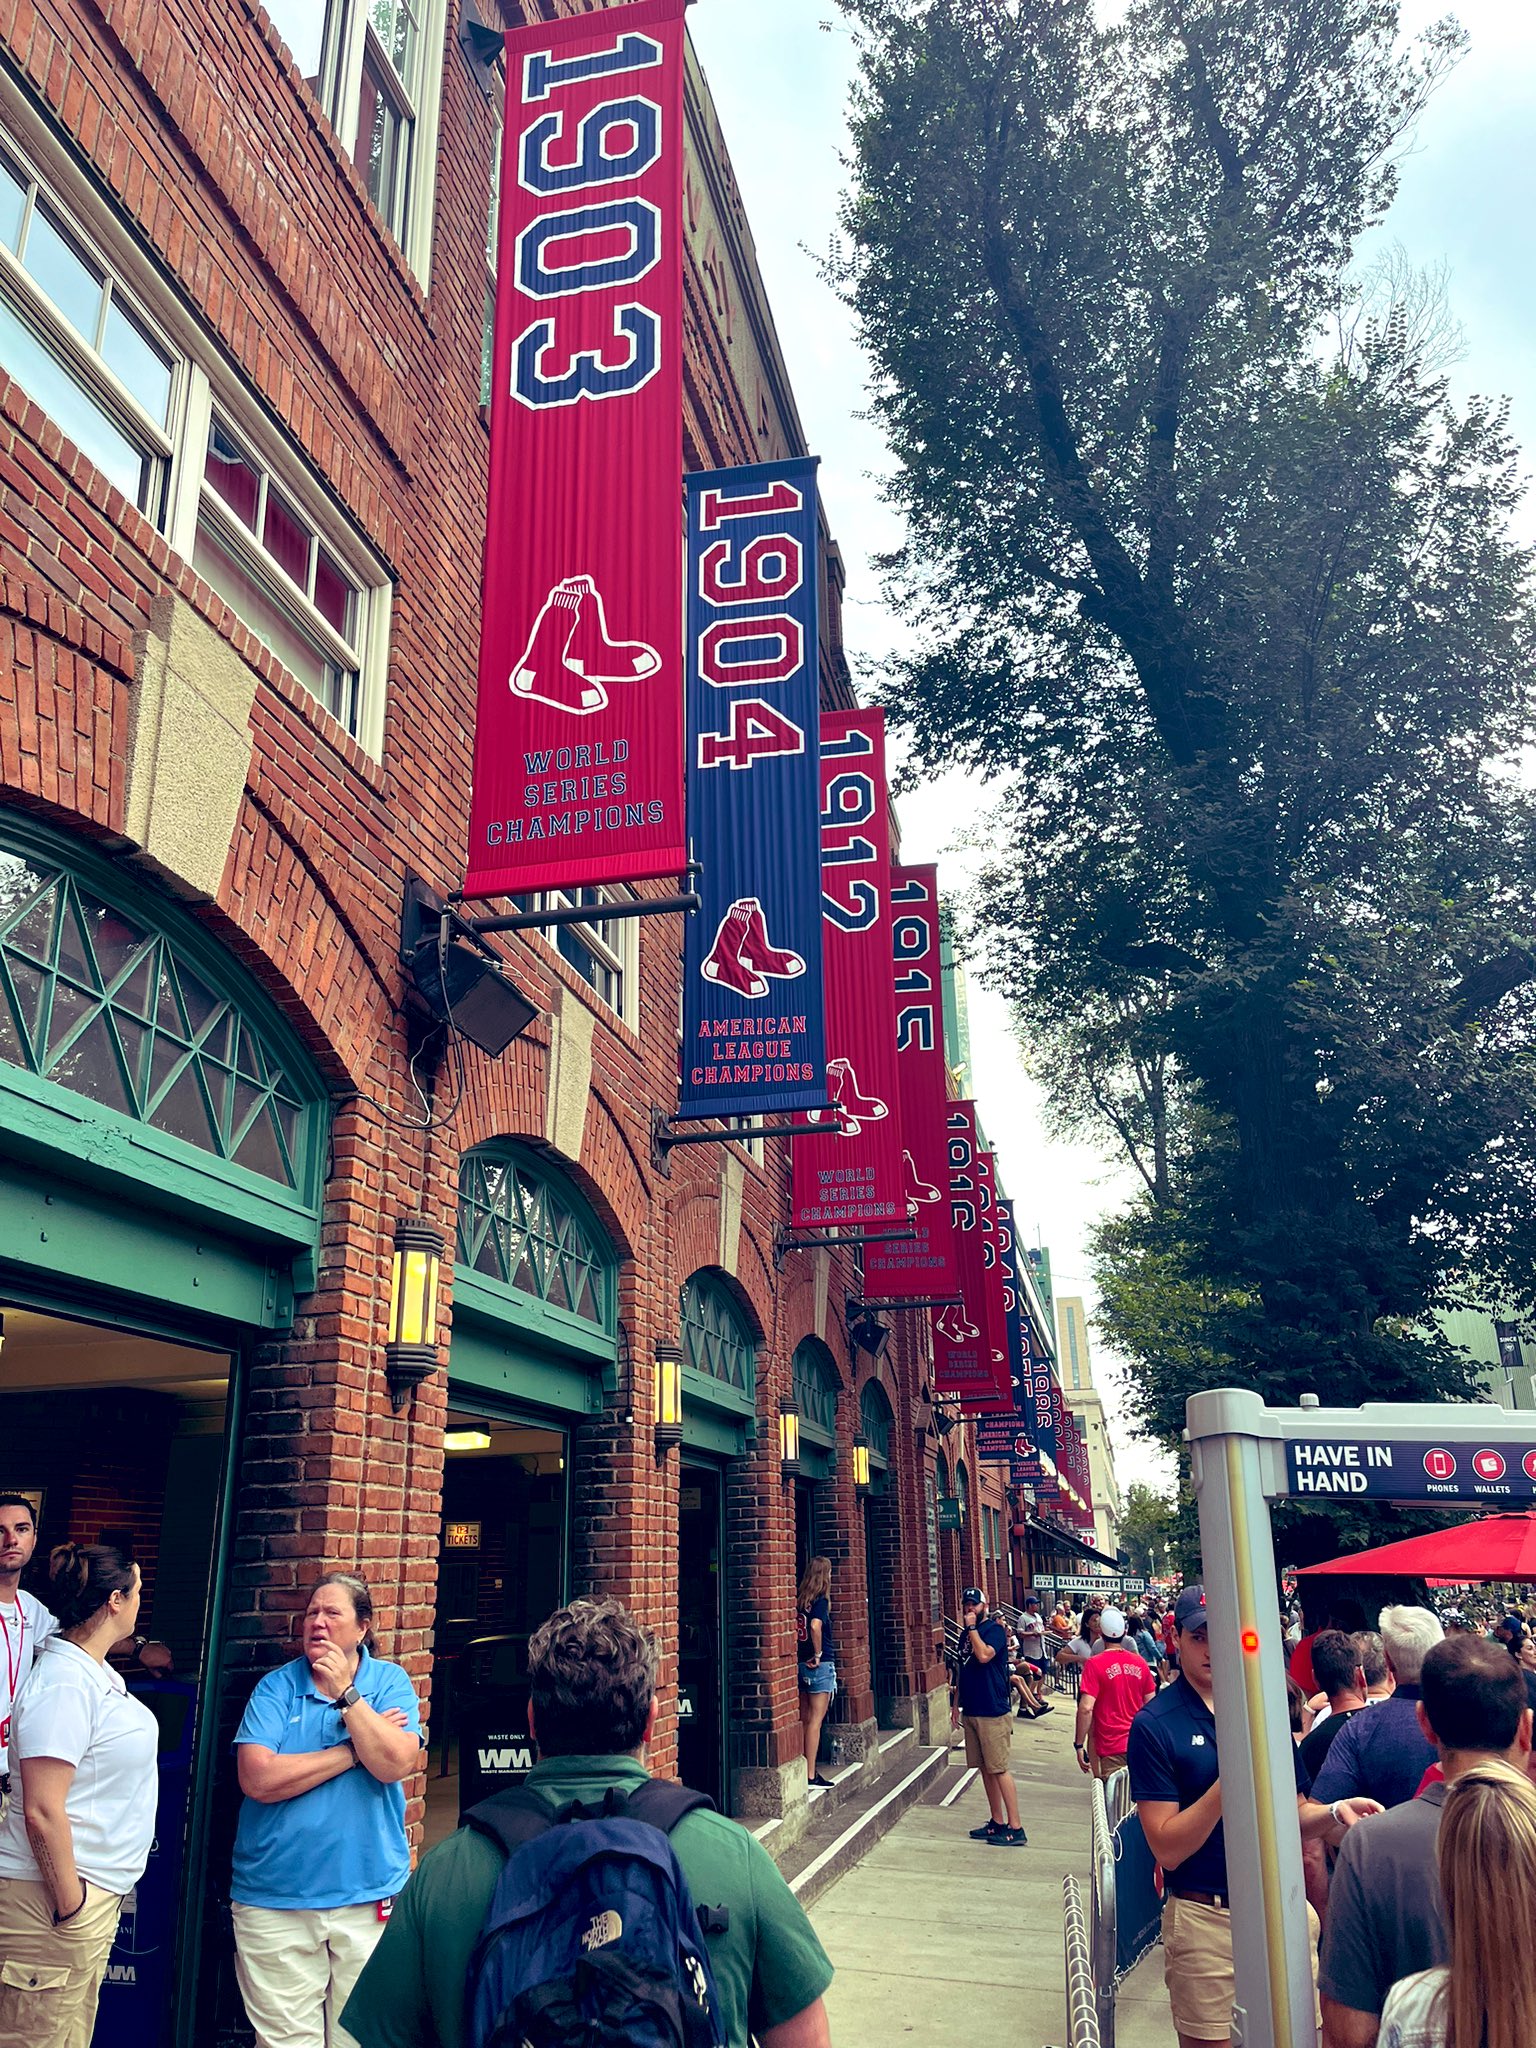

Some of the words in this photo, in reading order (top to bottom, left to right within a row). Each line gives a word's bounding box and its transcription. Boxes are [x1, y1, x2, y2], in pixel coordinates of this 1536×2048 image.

[510, 31, 663, 411] 1903
[698, 480, 804, 771] 1904
[524, 739, 630, 776] WORLD
[524, 772, 627, 807] SERIES
[486, 800, 664, 846] CHAMPIONS
[699, 1015, 807, 1037] AMERICAN
[712, 1040, 792, 1060] LEAGUE
[691, 1063, 814, 1085] CHAMPIONS
[817, 1167, 875, 1184] WORLD
[819, 1185, 875, 1203] SERIES
[800, 1202, 896, 1221] CHAMPIONS
[884, 1242, 929, 1254] SERIES
[869, 1256, 945, 1270] CHAMPIONS
[1033, 1363, 1052, 1428] 1986
[1294, 1445, 1360, 1467] HAVE
[1367, 1446, 1392, 1467] IN
[1296, 1471, 1368, 1493] HAND
[1427, 1483, 1459, 1493] PHONES
[1474, 1484, 1511, 1494] WALLETS
[447, 1535, 478, 1545] TICKETS
[1058, 1578, 1096, 1588] BALLPARK
[1101, 1580, 1119, 1588] BEER
[1105, 1662, 1122, 1680] RED
[1191, 1734, 1205, 1746] NB
[478, 1748, 533, 1768] WM
[590, 1914, 608, 1929] THE
[582, 1921, 609, 1946] NORTH
